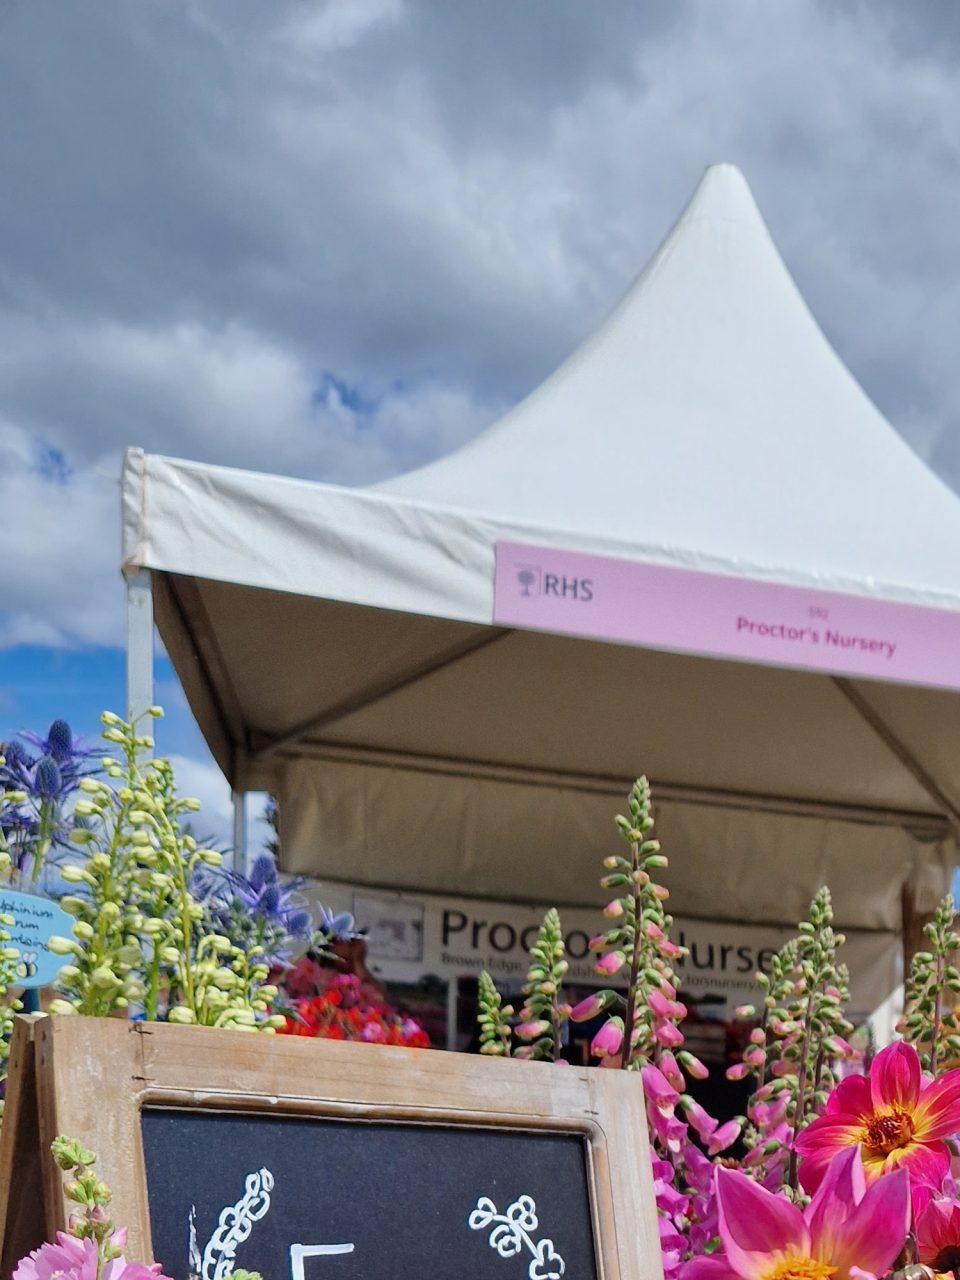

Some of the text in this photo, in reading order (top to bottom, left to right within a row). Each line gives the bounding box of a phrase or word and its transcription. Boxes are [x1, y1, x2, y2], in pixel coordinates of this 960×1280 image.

[543, 571, 595, 602] RHS
[736, 616, 897, 660] Proctor's Nursery
